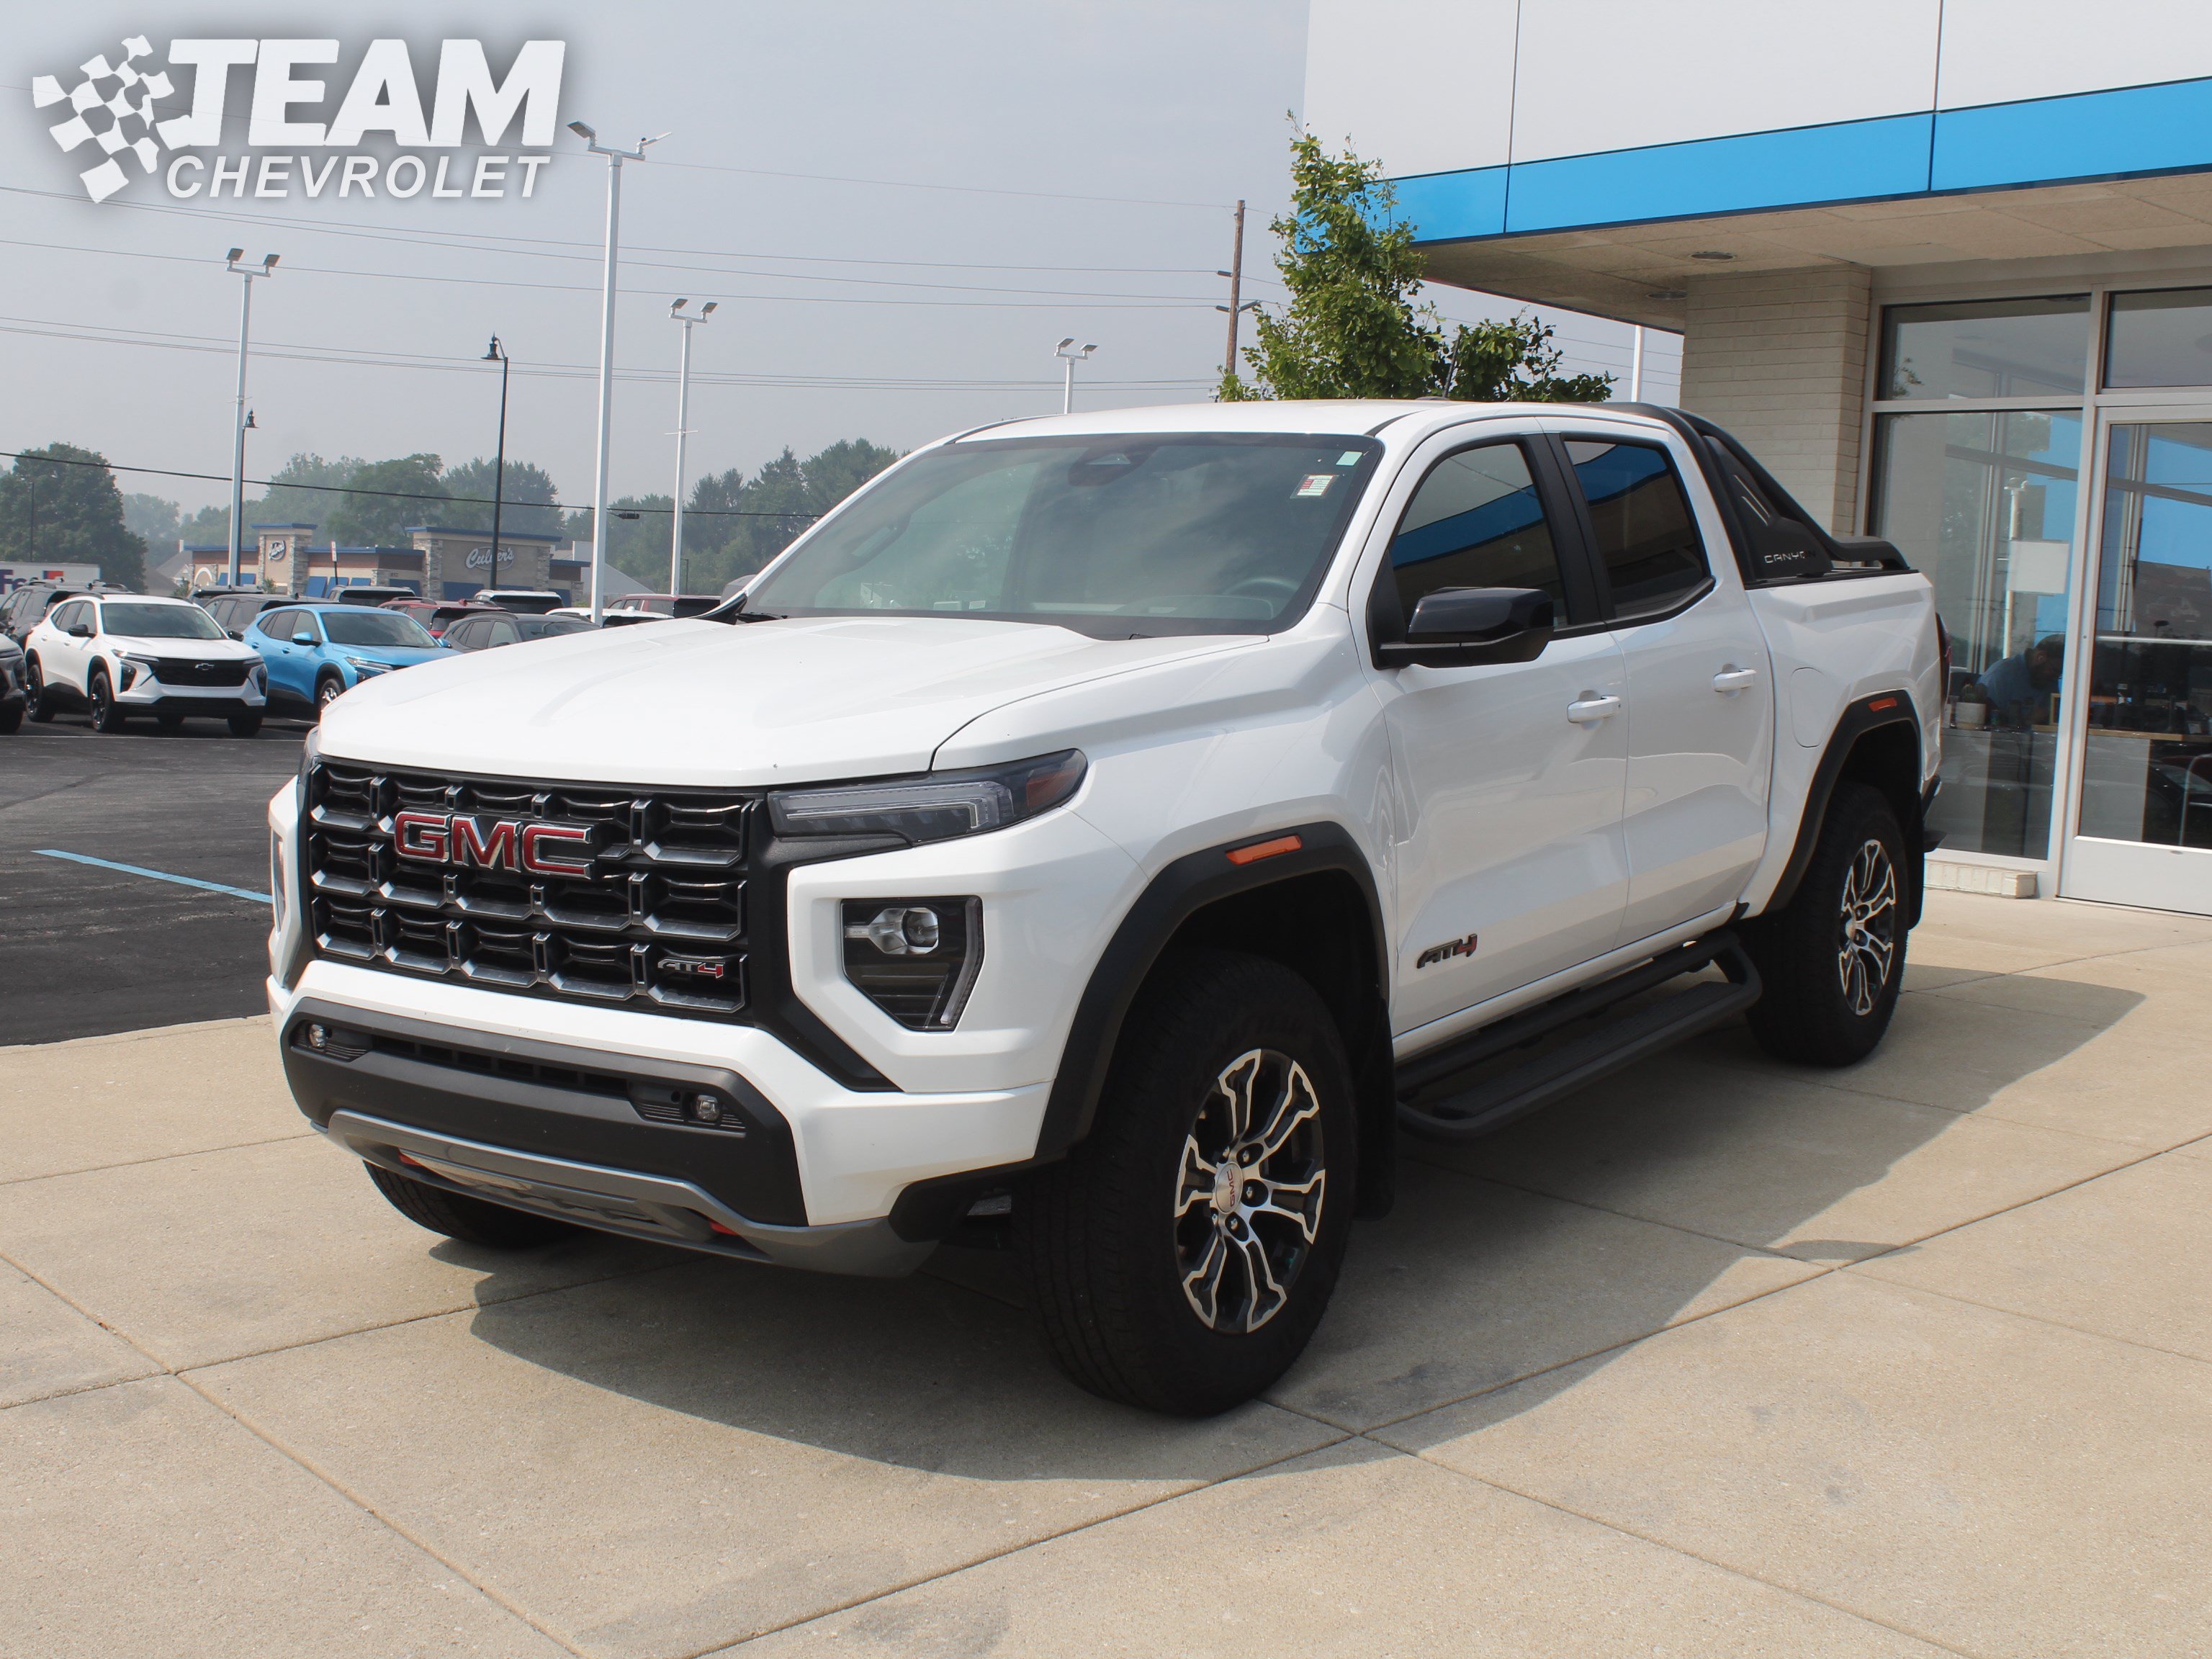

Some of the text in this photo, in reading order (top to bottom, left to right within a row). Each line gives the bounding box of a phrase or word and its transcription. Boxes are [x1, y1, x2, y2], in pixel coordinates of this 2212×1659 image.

[394, 811, 594, 879] GMC
[657, 958, 724, 979] AT4
[1416, 933, 1478, 969] AT4
[1226, 1169, 1236, 1207] GMC
